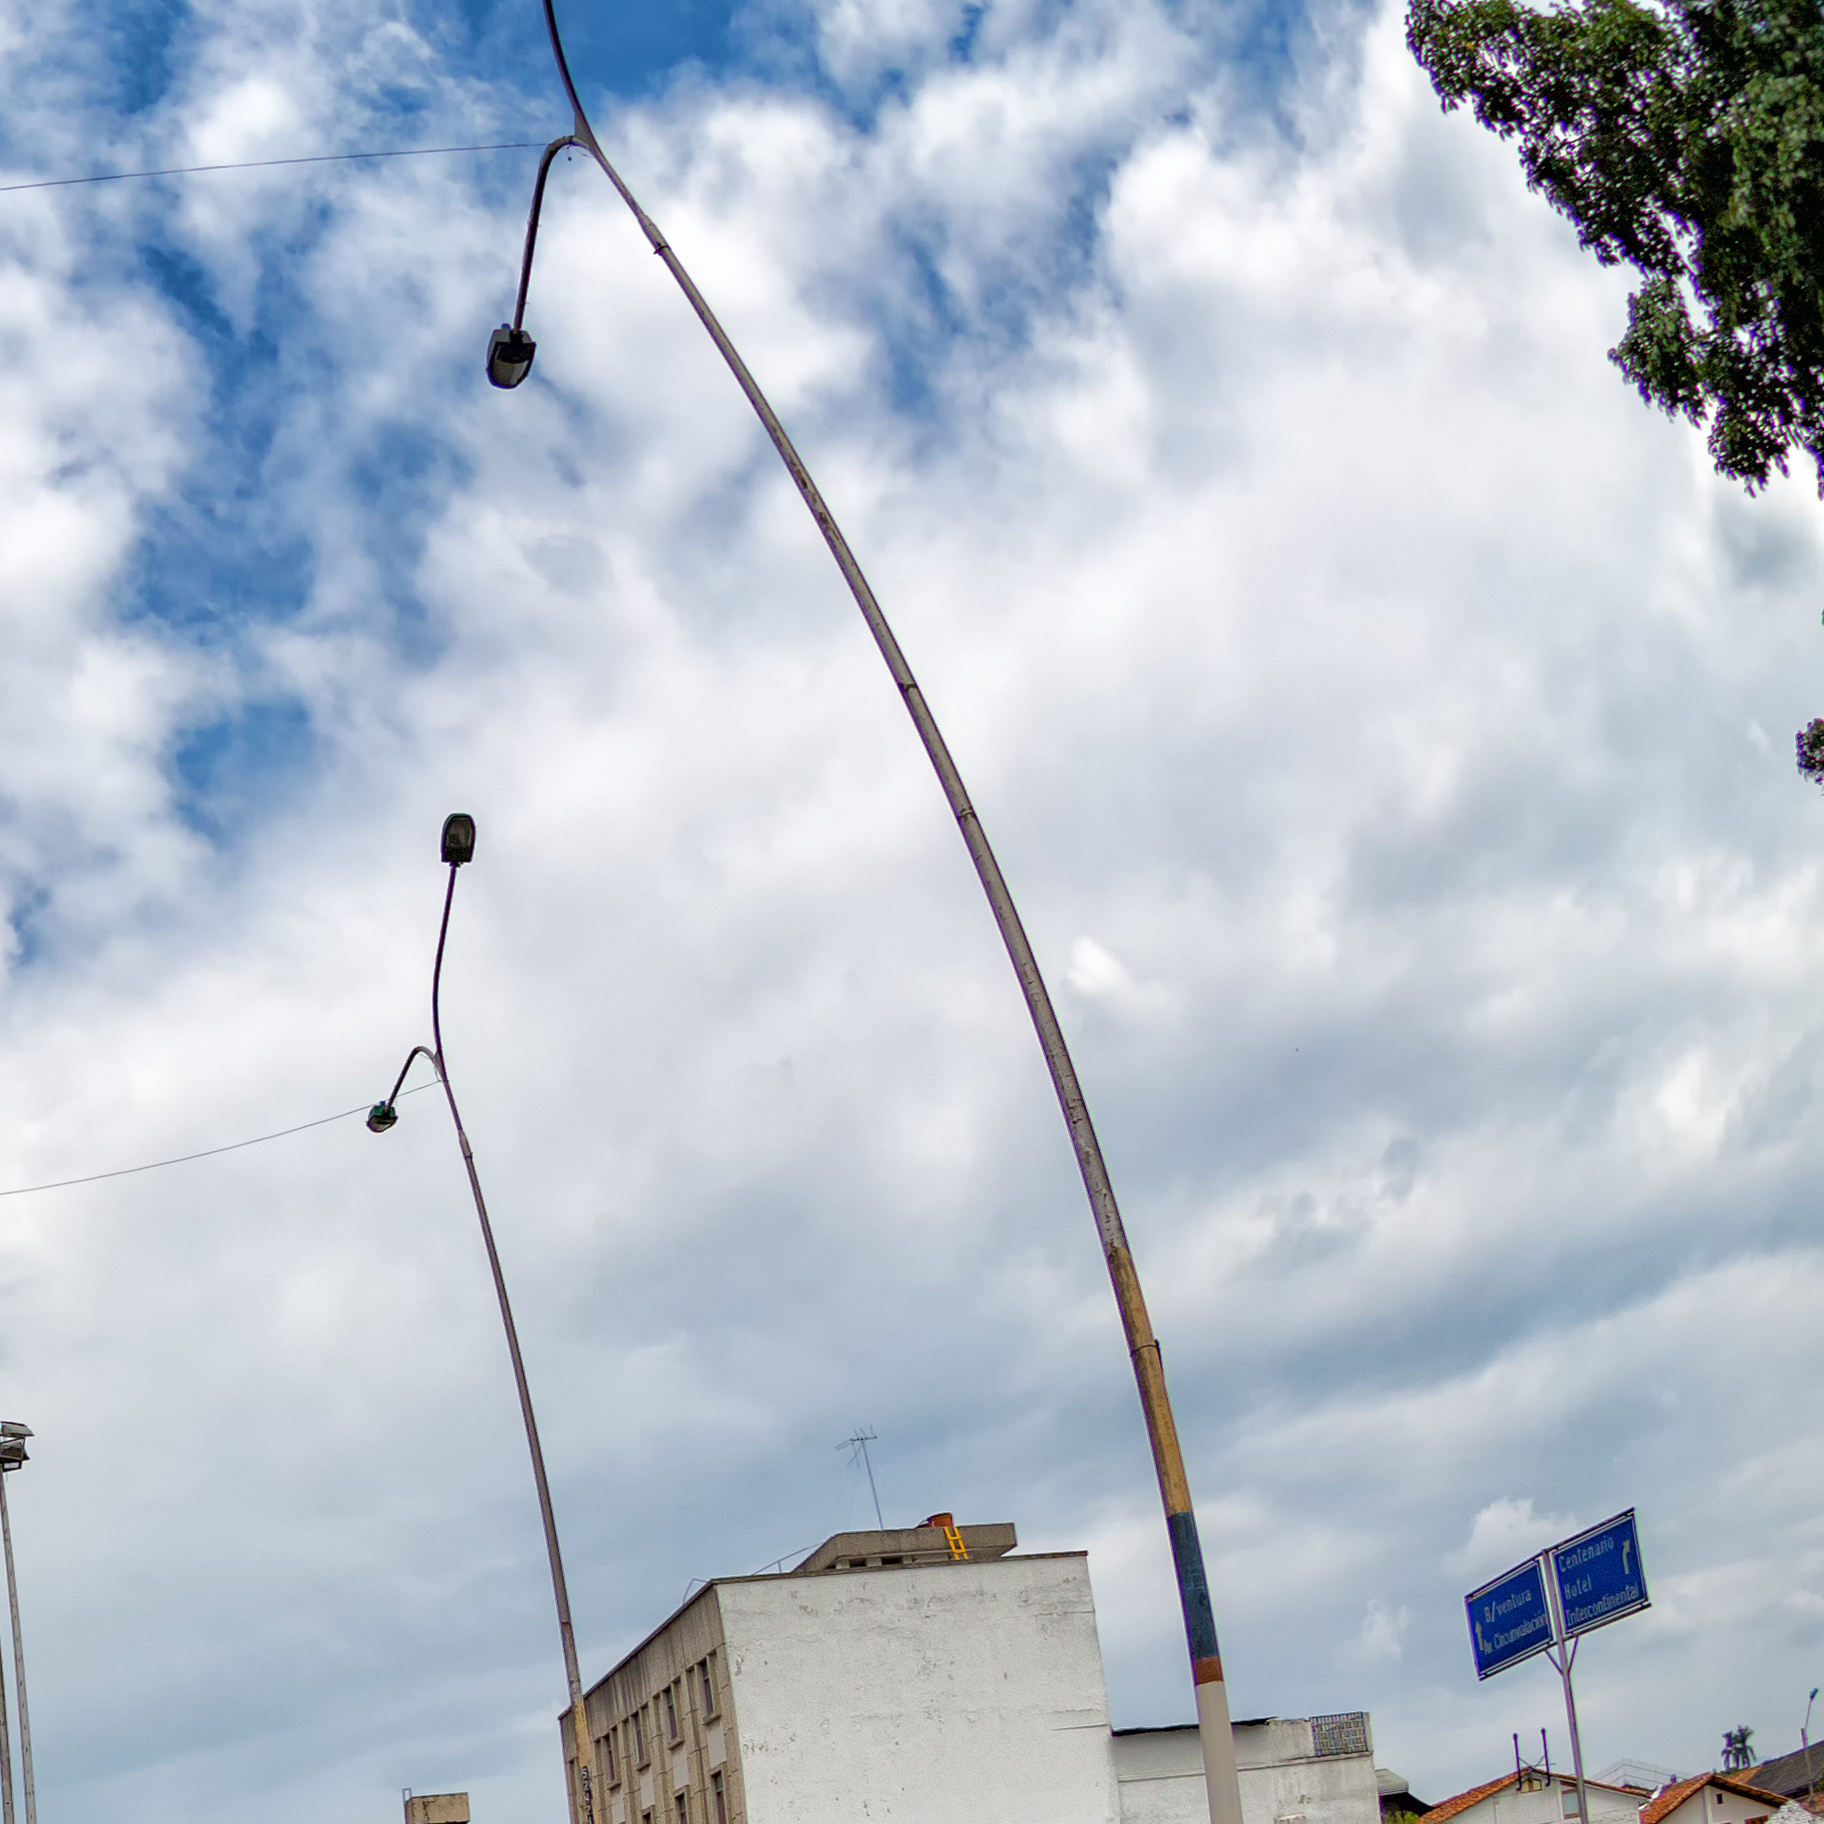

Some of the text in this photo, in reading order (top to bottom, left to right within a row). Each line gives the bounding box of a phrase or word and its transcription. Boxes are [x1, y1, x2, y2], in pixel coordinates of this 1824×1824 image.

[1558, 1536, 1615, 1573] Centenario
[1564, 1575, 1593, 1600] Hotel
[1566, 1581, 1640, 1628] Intercontinental
